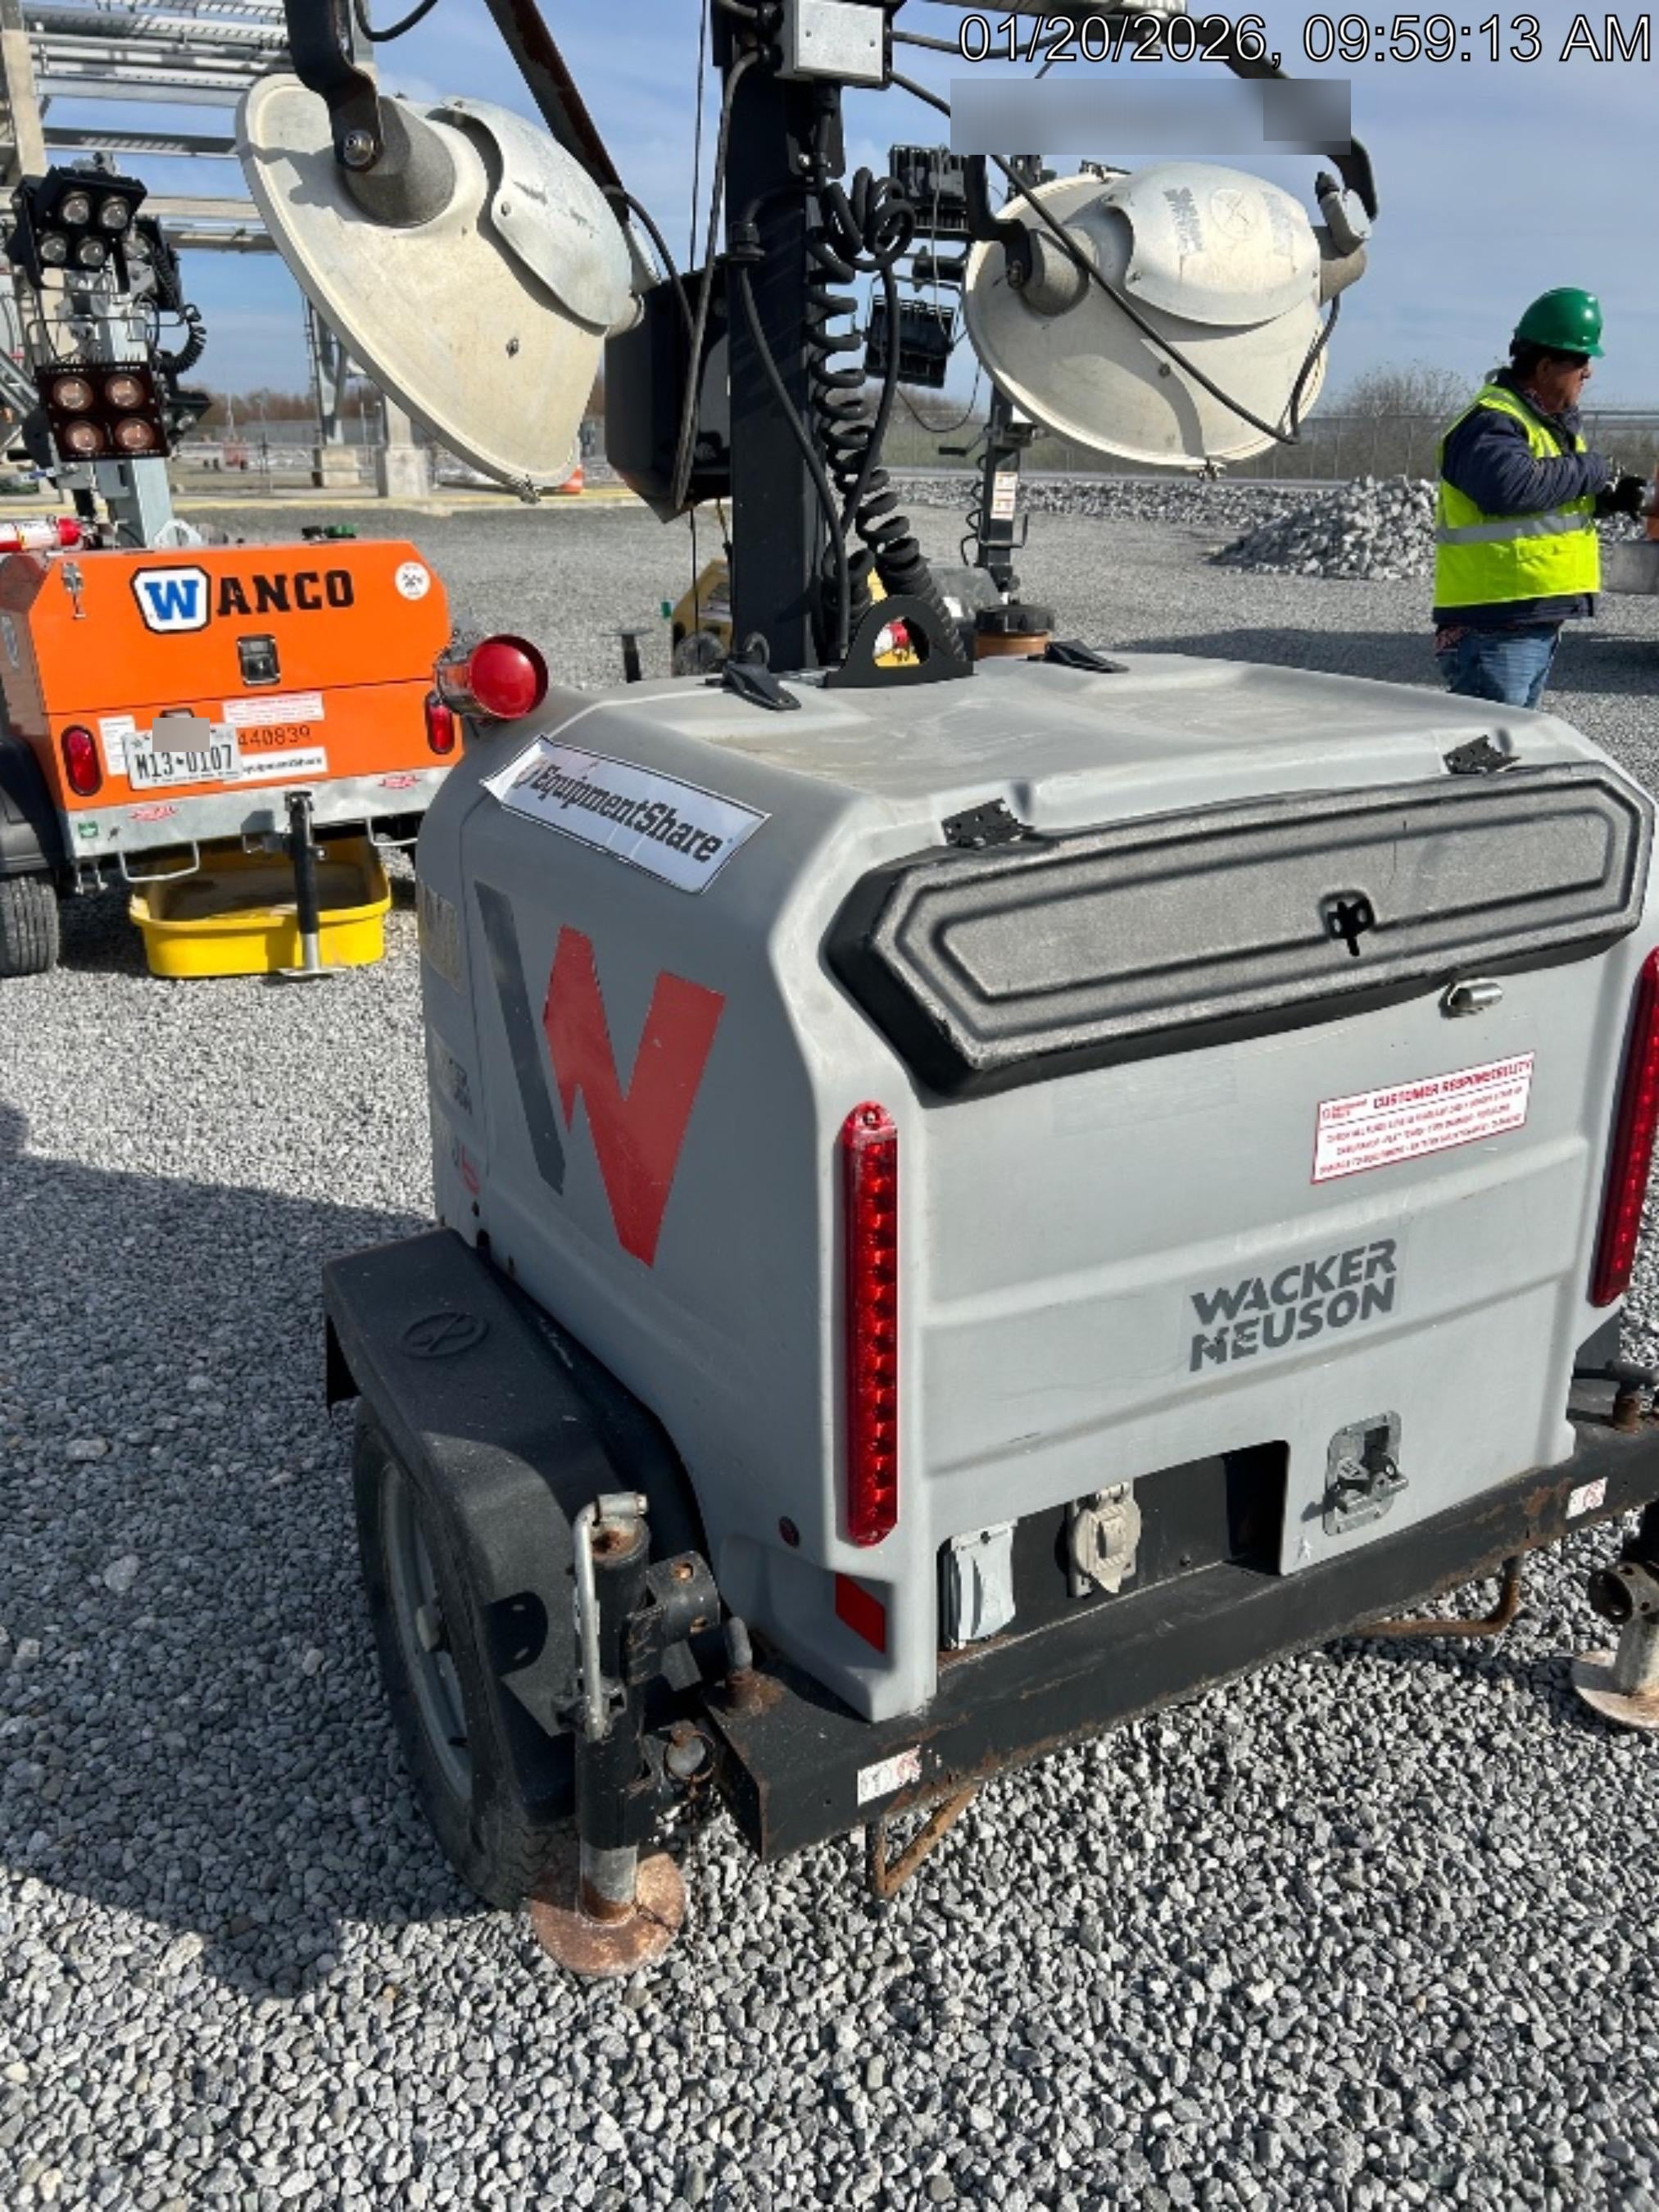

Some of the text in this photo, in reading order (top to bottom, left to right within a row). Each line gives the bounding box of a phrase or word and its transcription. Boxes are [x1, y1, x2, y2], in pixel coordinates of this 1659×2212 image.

[144, 569, 355, 620] WANCO
[530, 764, 724, 862] EquipmentShare
[1372, 1083, 1439, 1109] CUSTOMER
[1440, 1058, 1533, 1093] RESPONSIBILITY
[1190, 1238, 1397, 1326] WACKER
[1190, 1275, 1397, 1372] NEUSON
